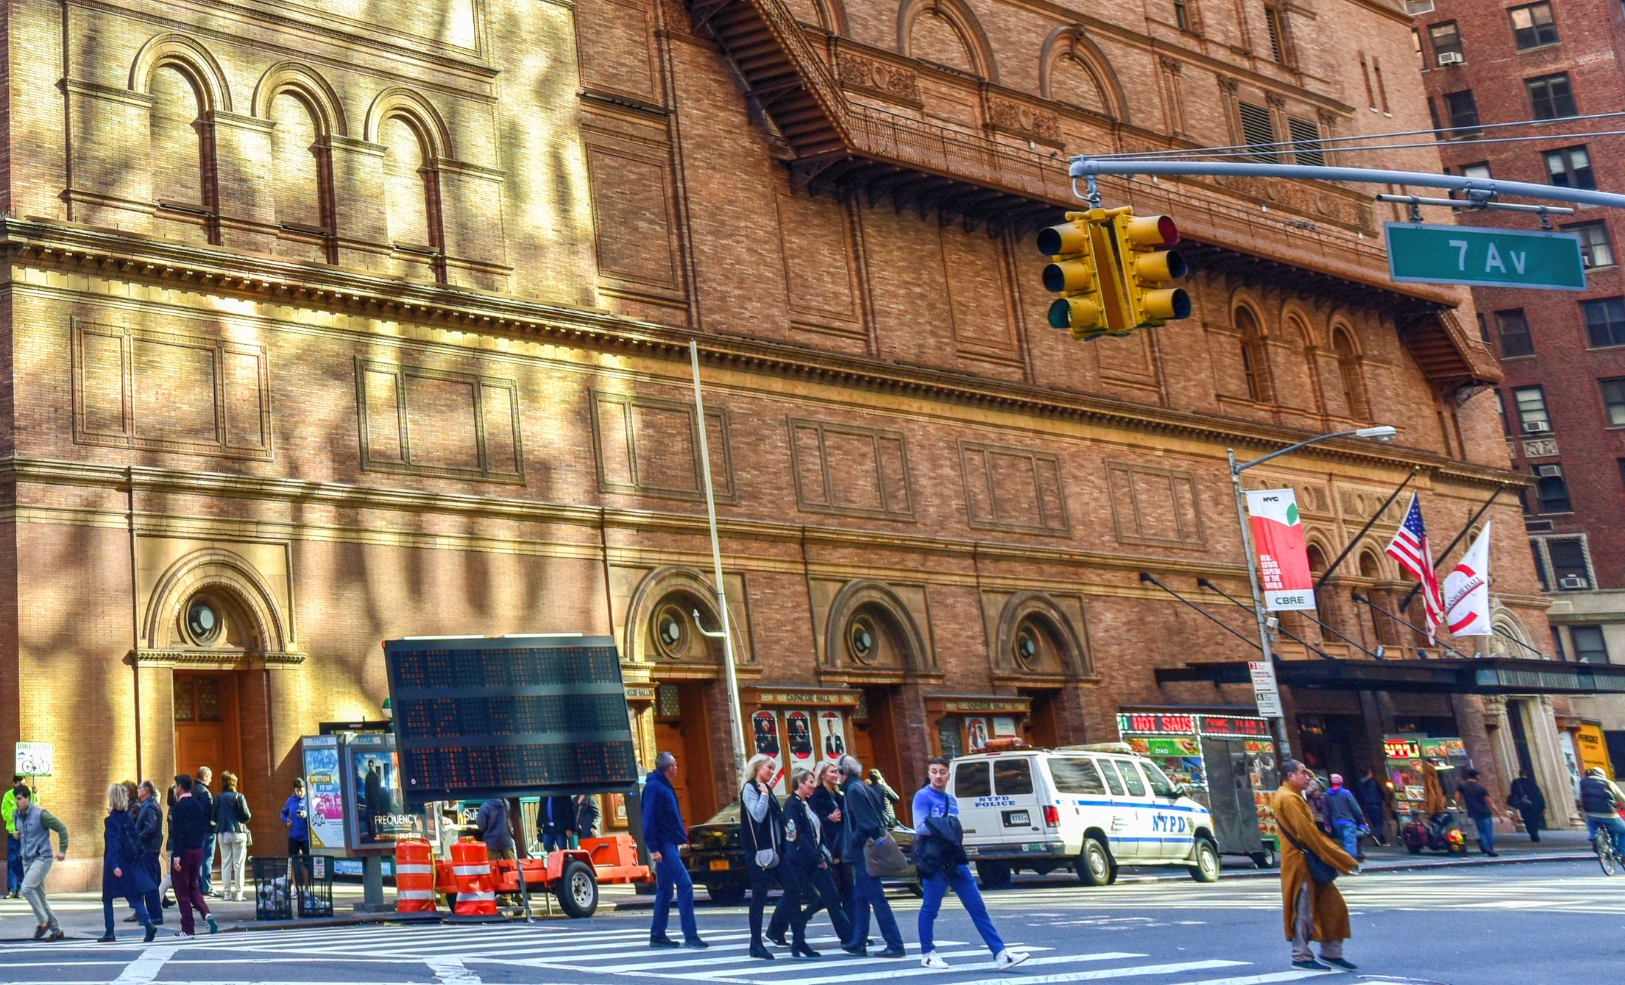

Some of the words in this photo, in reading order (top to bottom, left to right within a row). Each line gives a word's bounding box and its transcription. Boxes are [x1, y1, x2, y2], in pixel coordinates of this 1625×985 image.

[1449, 240, 1468, 271] 7
[1464, 576, 1482, 592] HALL
[1275, 596, 1305, 605] CBRE
[1132, 717, 1156, 731] HOT
[411, 743, 548, 788] TIMES
[374, 814, 418, 826] FREQUENCY
[1152, 815, 1186, 833] NYPD
